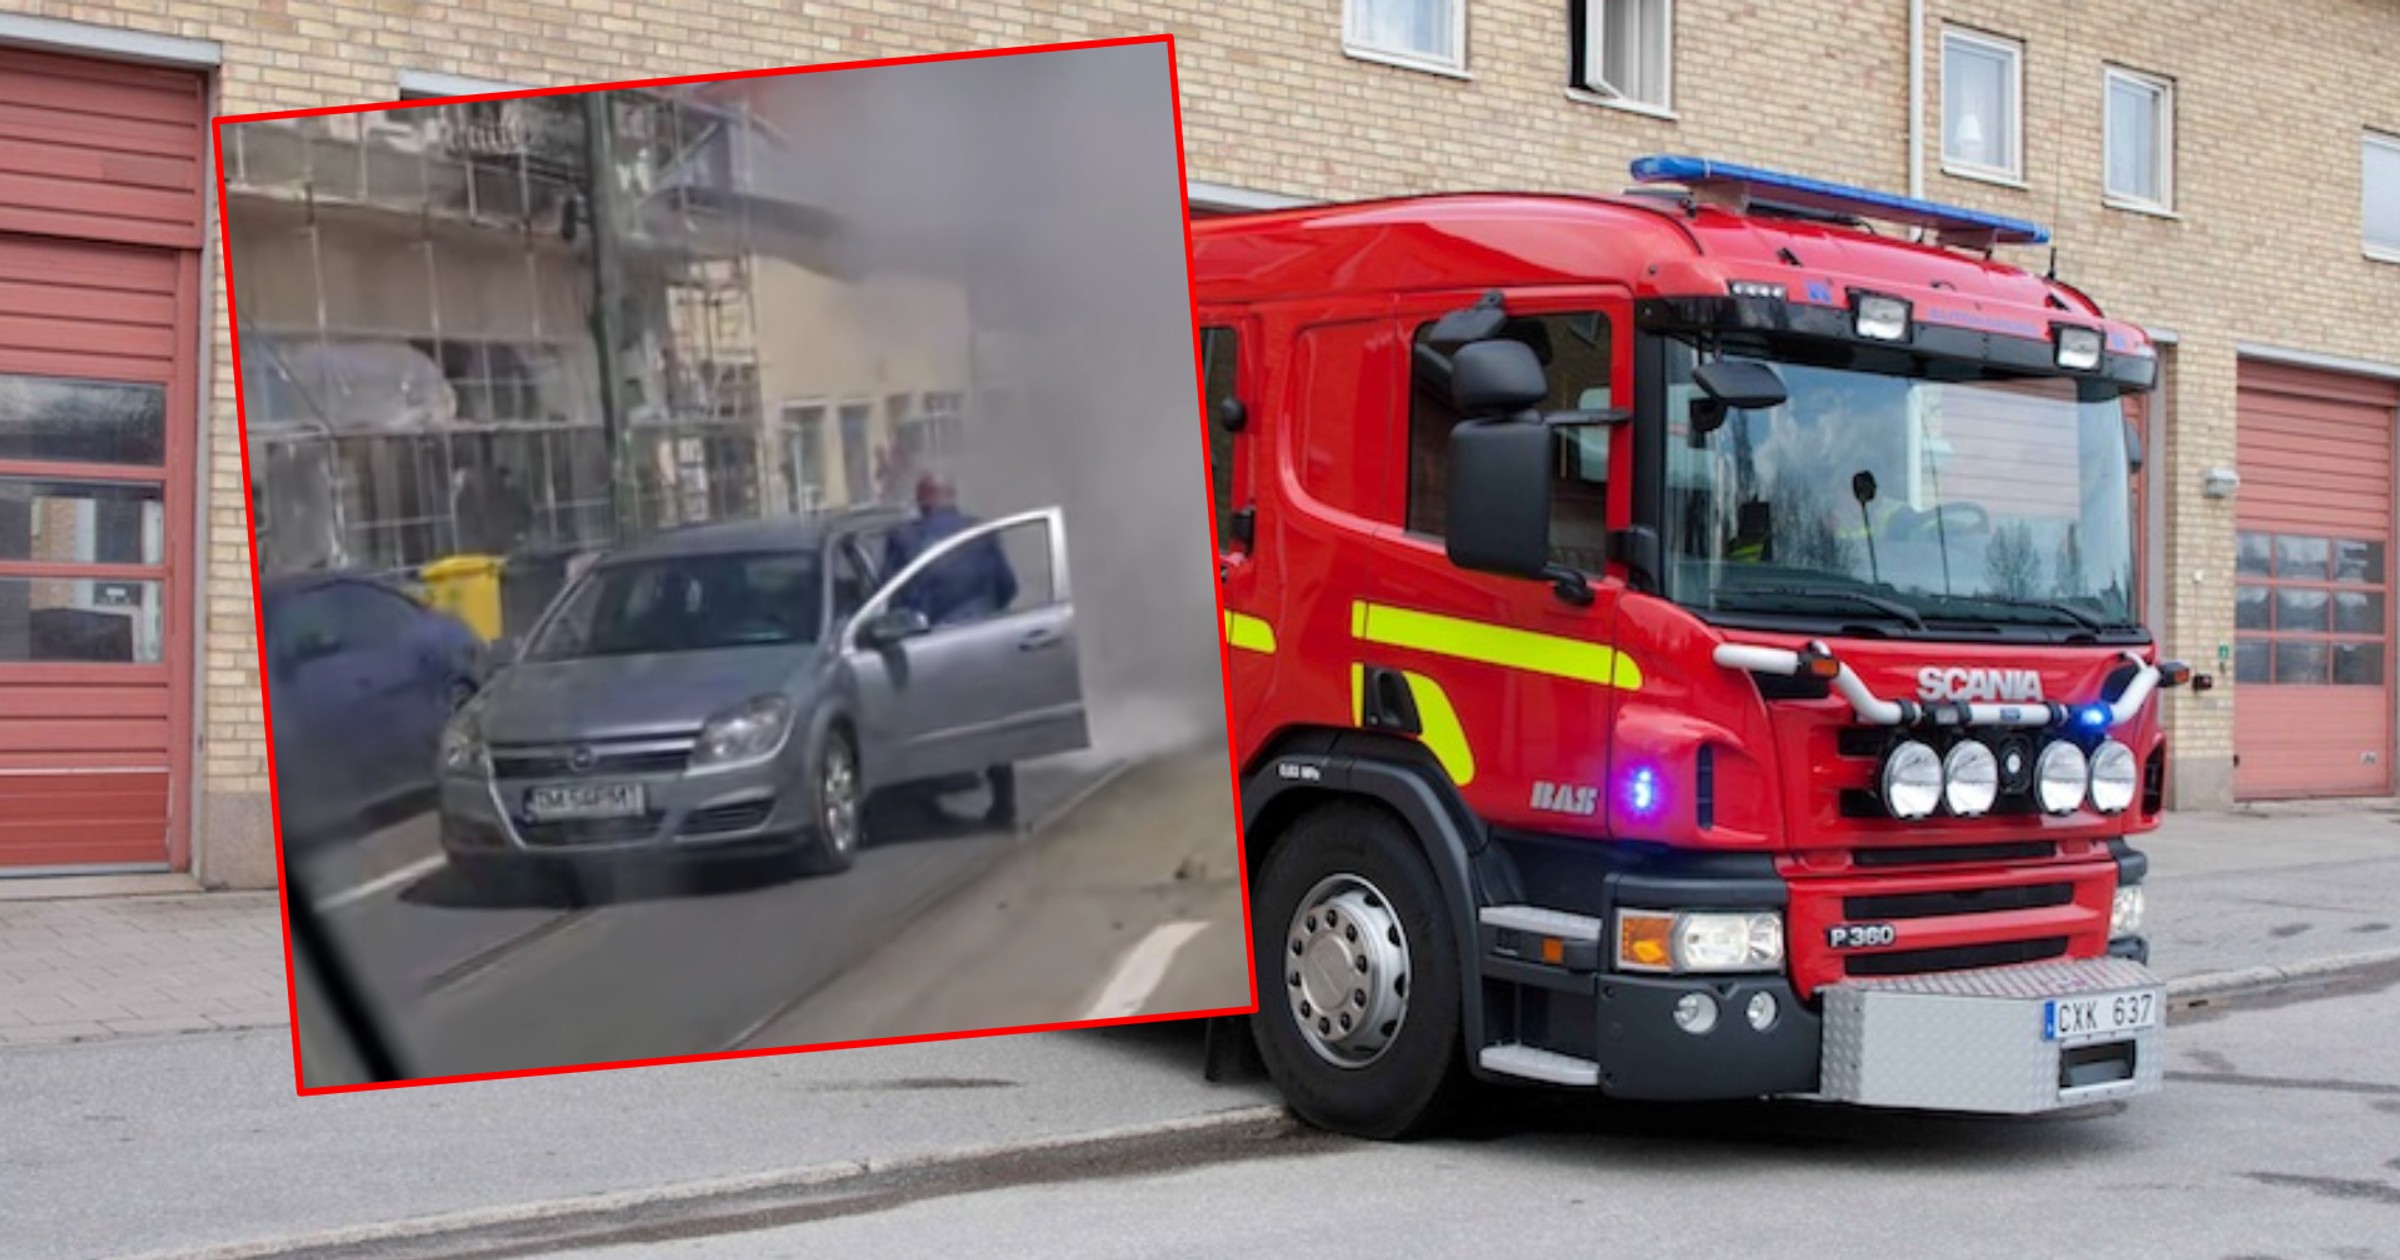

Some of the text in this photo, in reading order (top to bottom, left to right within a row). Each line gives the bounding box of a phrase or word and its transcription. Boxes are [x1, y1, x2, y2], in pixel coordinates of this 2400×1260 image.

[1916, 666, 2044, 701] SCANIA
[1830, 926, 1894, 948] P 360
[2059, 1001, 2098, 1033] CXK
[2113, 993, 2153, 1027] 637
